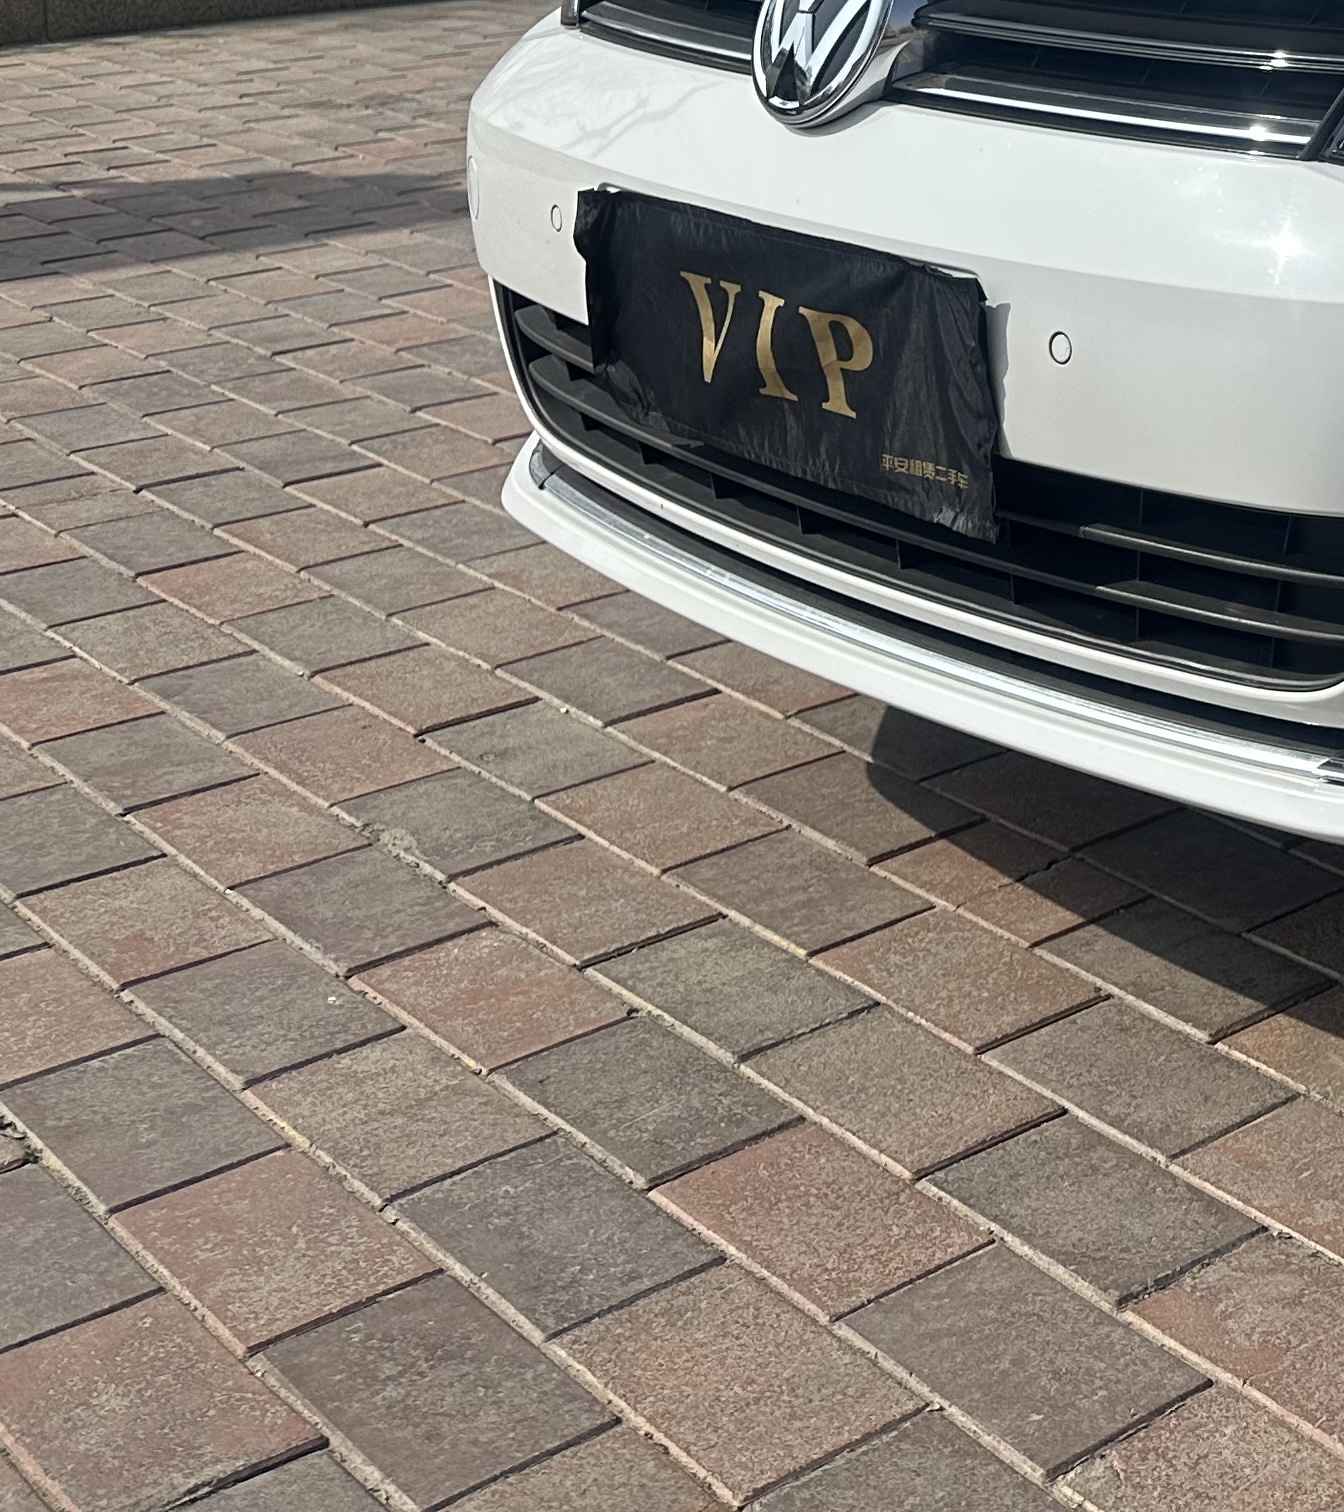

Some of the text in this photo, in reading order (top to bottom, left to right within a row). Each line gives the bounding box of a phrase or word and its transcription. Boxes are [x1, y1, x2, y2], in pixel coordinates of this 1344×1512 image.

[680, 271, 873, 419] VIP
[881, 453, 969, 489] 平安租赁二手车
